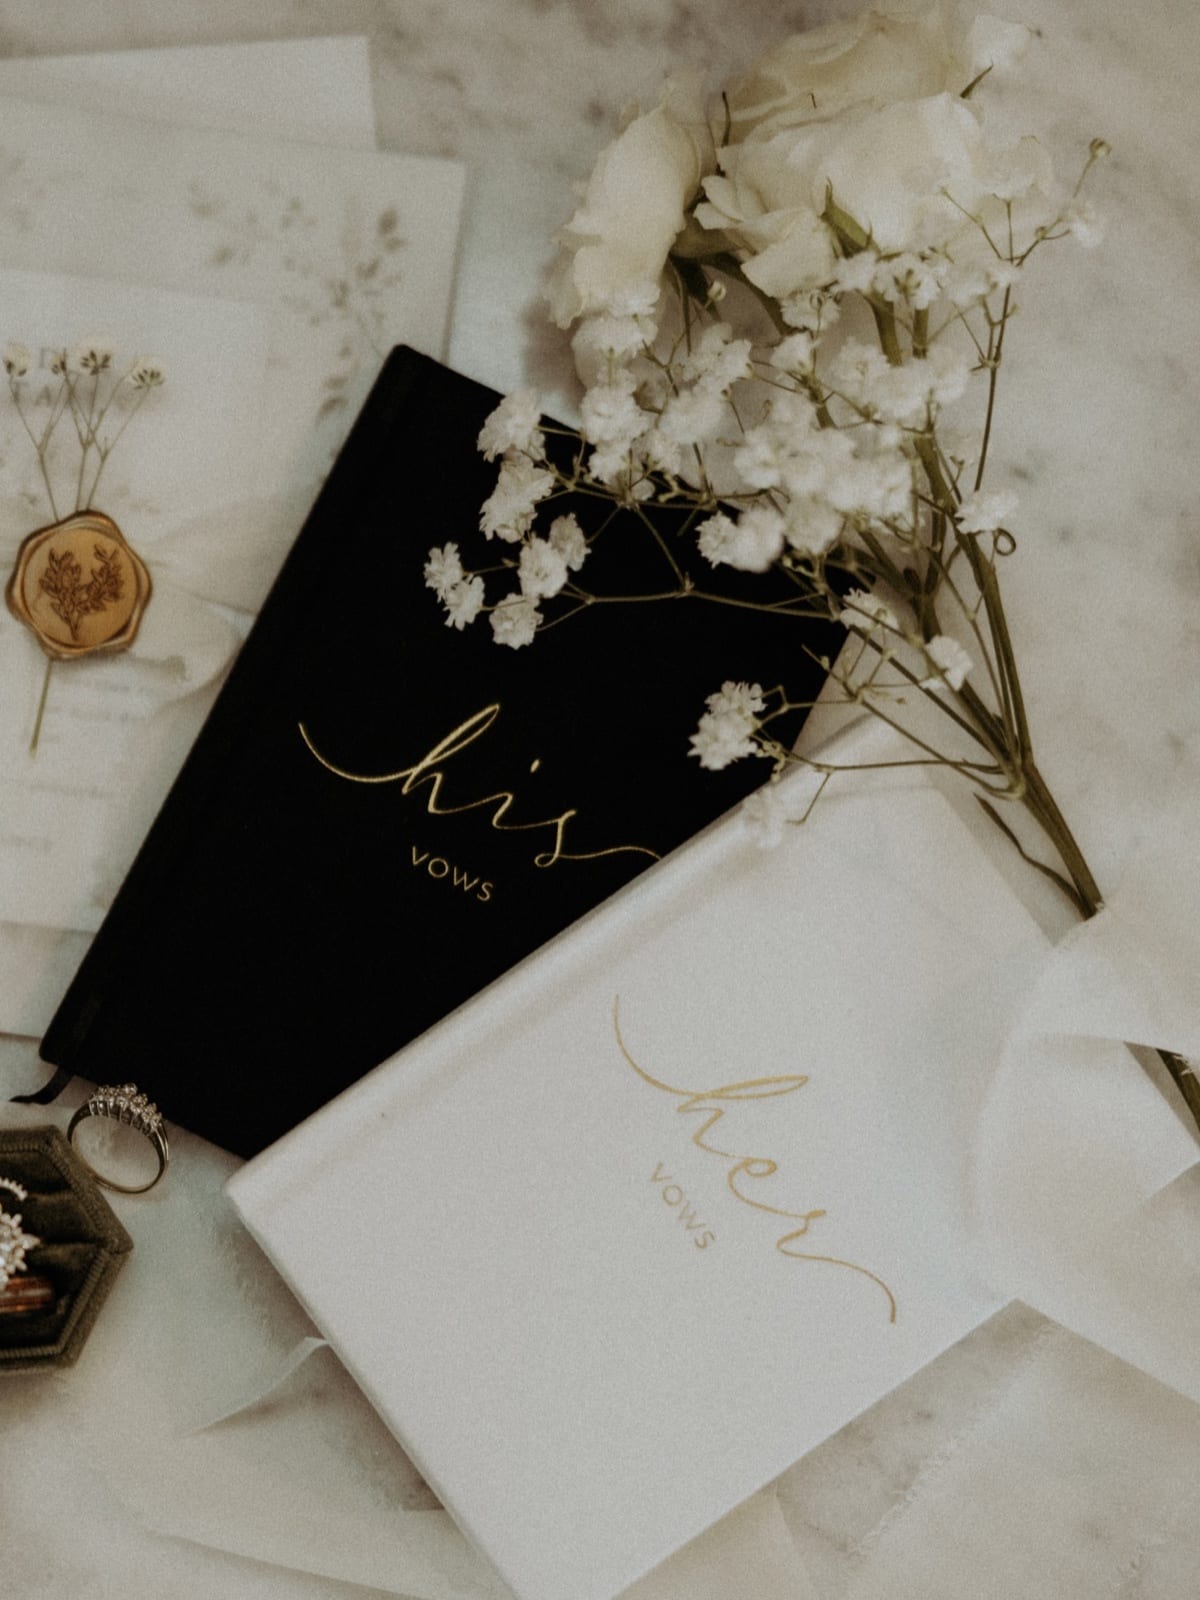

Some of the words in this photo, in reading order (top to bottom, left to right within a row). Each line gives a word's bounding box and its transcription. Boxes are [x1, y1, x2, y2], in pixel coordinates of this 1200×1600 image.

[298, 703, 662, 867] his
[411, 844, 495, 902] VOWS
[612, 993, 897, 1324] her
[650, 1161, 715, 1250] VOWS
